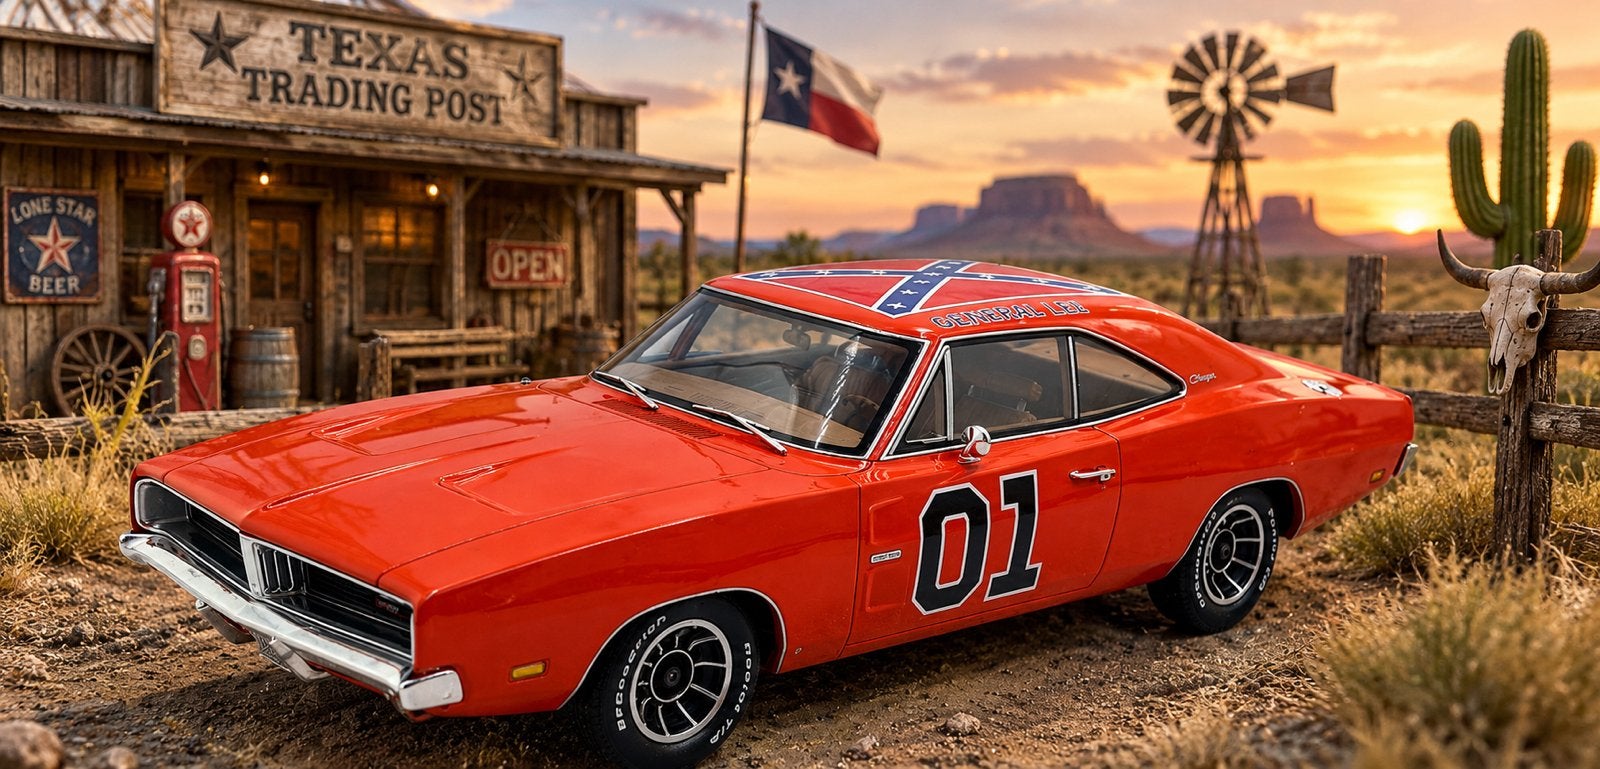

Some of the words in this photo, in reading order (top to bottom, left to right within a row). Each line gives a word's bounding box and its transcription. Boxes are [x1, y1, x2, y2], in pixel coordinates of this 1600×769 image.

[289, 20, 470, 81] TEXAS
[241, 66, 412, 116] TRADING
[425, 87, 506, 124] POST
[10, 196, 52, 225] LONE
[56, 196, 97, 226] STAR
[492, 247, 564, 281] OPEN
[28, 275, 81, 295] BEER
[931, 305, 1045, 329] GENERAL
[1041, 300, 1090, 317] LEE
[911, 469, 1043, 616] 01
